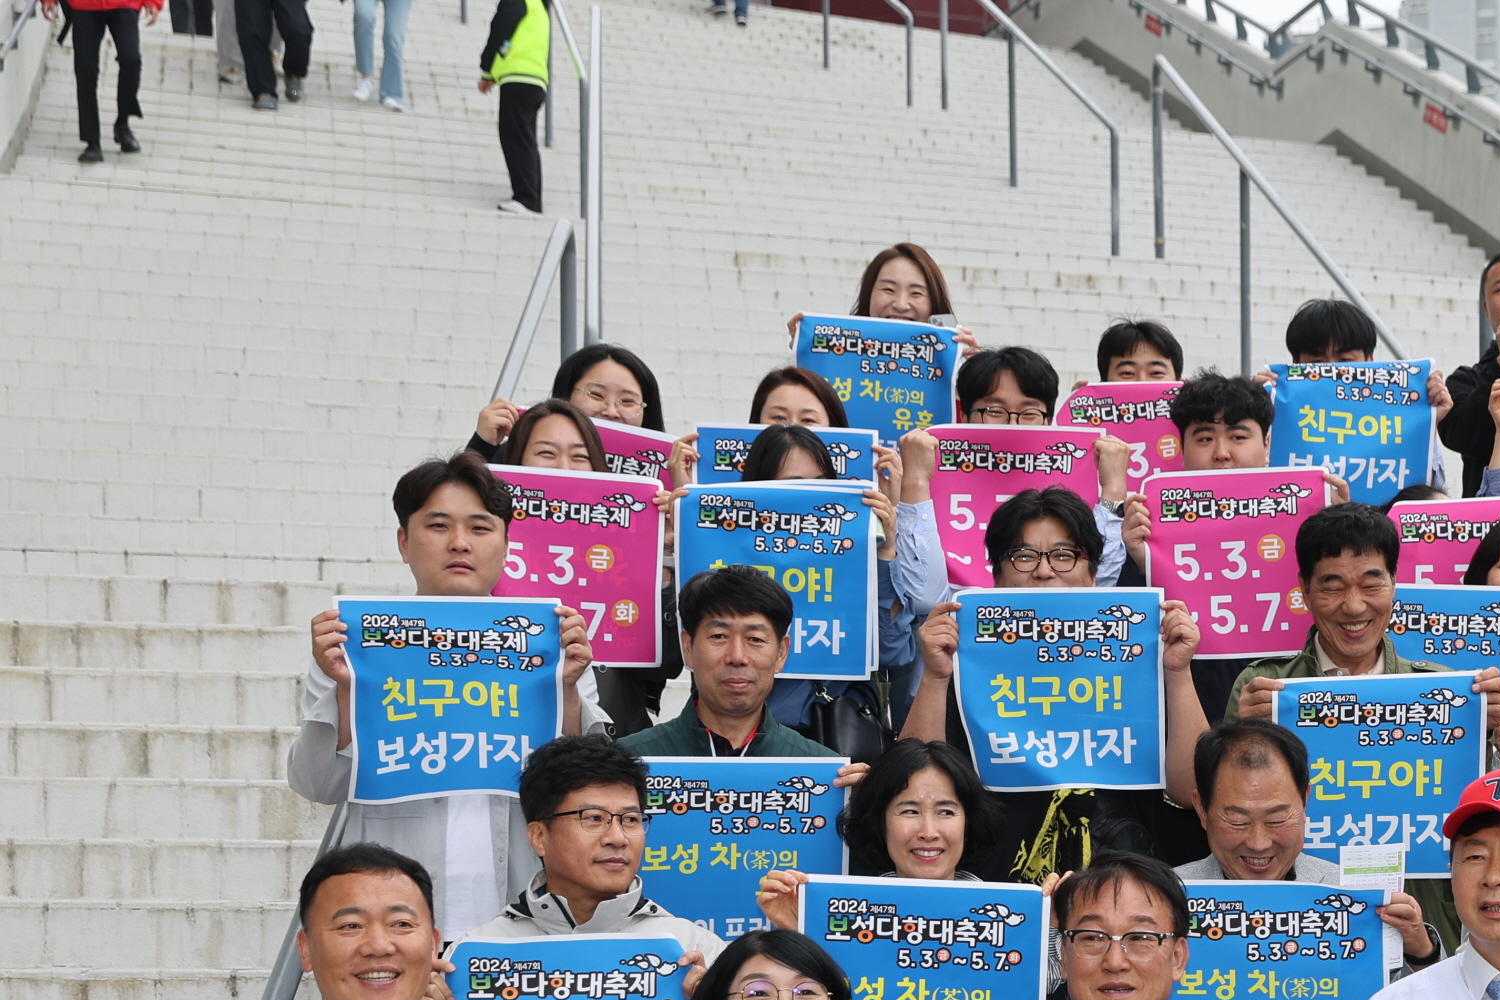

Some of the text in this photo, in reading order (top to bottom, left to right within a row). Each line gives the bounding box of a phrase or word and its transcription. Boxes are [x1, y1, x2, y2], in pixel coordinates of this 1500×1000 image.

[812, 336, 934, 362] 보성다향대축제
[1287, 361, 1408, 388] 보성다향대축제
[1072, 399, 1171, 425] 보성다향대축
[1298, 404, 1402, 444] 친구야!
[715, 439, 744, 450] 2024
[938, 451, 1072, 474] 보성다향대축제
[700, 495, 731, 507] 2024
[1161, 488, 1191, 501] 2024
[511, 497, 630, 528] 성다향대축제
[1160, 496, 1297, 523] 보성다향대축제
[1400, 513, 1428, 523] 2024
[698, 508, 841, 538] 보성다향대축제
[363, 615, 399, 628] 2024
[978, 607, 1011, 619] 2024
[362, 628, 527, 654] 보성다향대축제
[976, 618, 1129, 644] 보성다향대축제
[381, 675, 520, 724] 친구야!
[990, 673, 1122, 718] 친구야!
[1299, 691, 1332, 704] 2024
[1297, 702, 1450, 729] 보성다향대축제
[376, 730, 534, 777] 보성가자
[988, 726, 1137, 768] 보성가자
[645, 777, 682, 790] 2024
[1308, 757, 1443, 801] 친구야!
[643, 790, 810, 815] 보성다향대축제
[639, 840, 699, 875] 보성
[829, 899, 895, 914] 2024 제47회
[826, 915, 1004, 947] 보성다향대축제
[469, 958, 541, 972] 2024 제47회
[1176, 969, 1236, 1000] 보성
